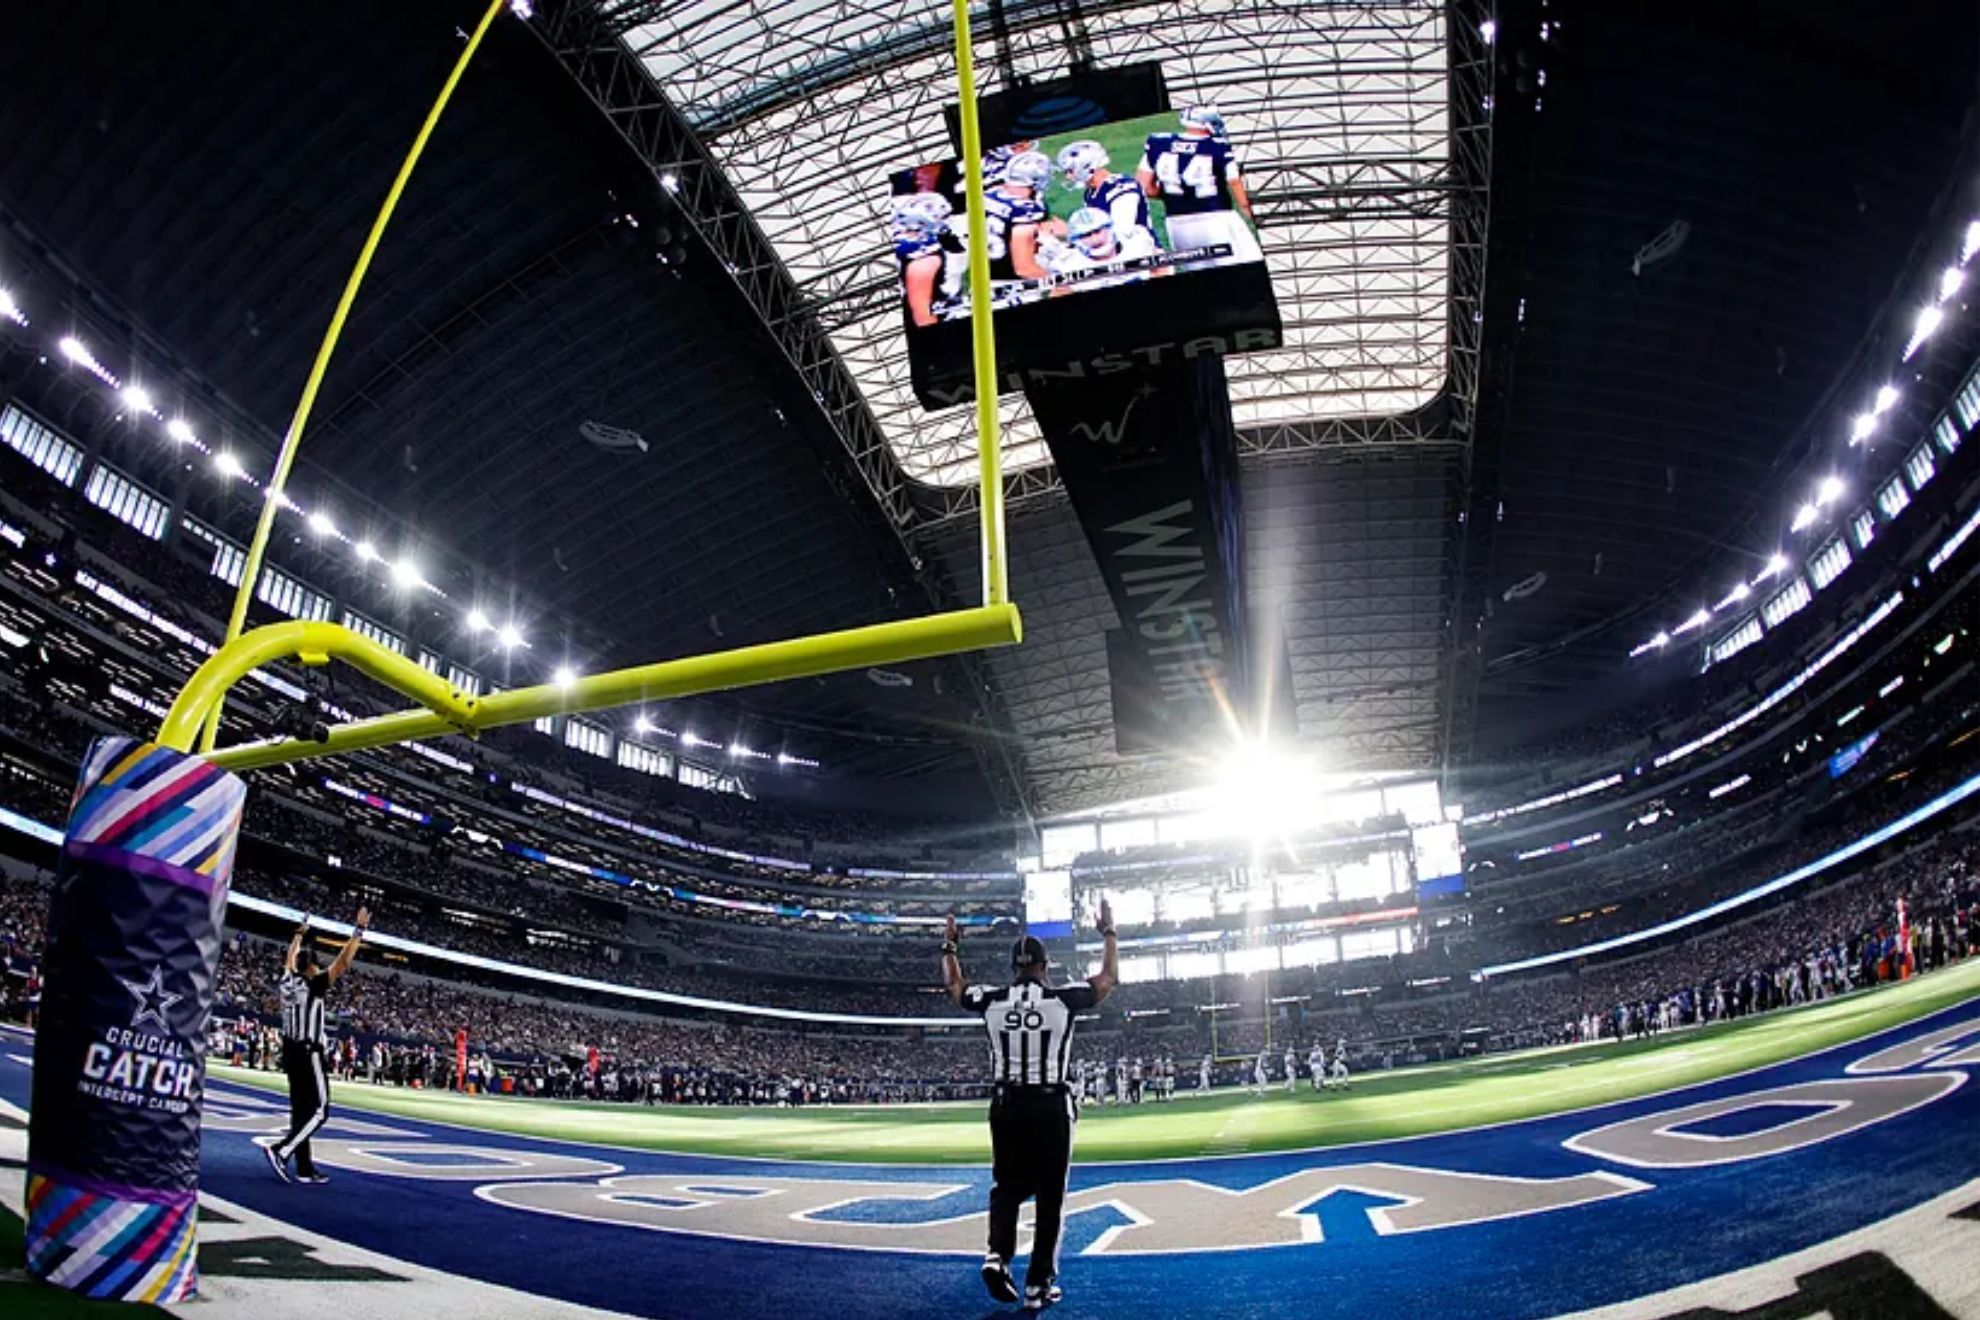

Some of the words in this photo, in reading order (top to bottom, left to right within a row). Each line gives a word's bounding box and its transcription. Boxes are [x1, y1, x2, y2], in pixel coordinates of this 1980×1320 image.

[1156, 151, 1218, 199] 44
[927, 328, 1276, 402] WINSTAR
[1103, 499, 1227, 701] WINSTAR
[106, 1026, 184, 1058] CRUCIAL
[1004, 1010, 1044, 1031] 90
[77, 1080, 144, 1106] INTERCEPT
[83, 1042, 195, 1097] CATCH
